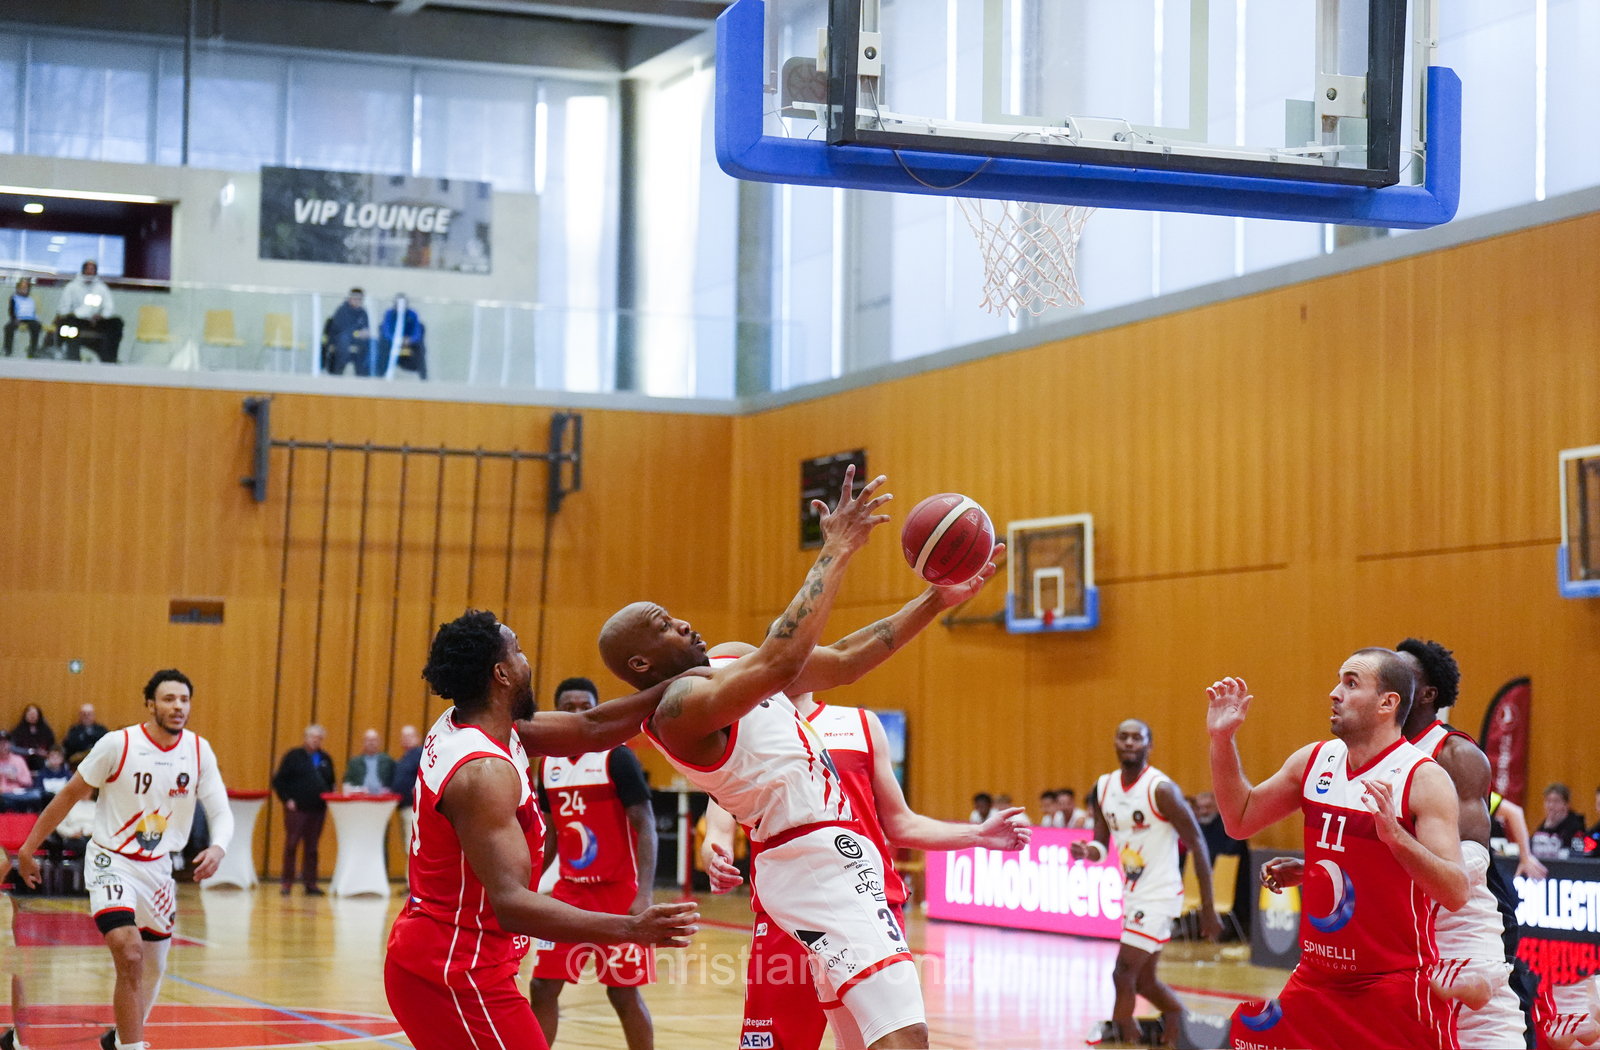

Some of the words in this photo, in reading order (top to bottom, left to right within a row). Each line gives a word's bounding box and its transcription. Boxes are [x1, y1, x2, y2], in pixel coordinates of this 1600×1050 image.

[294, 198, 340, 226] VIP
[343, 202, 451, 234] LOUNGE
[133, 771, 153, 795] 19
[558, 790, 587, 817] 24
[1316, 812, 1347, 853] 11
[945, 850, 973, 905] la
[102, 884, 124, 901] 19
[877, 908, 901, 941] 3
[607, 944, 641, 968] 24
[1303, 940, 1356, 960] SPINELLI
[742, 1034, 772, 1047] AEM
